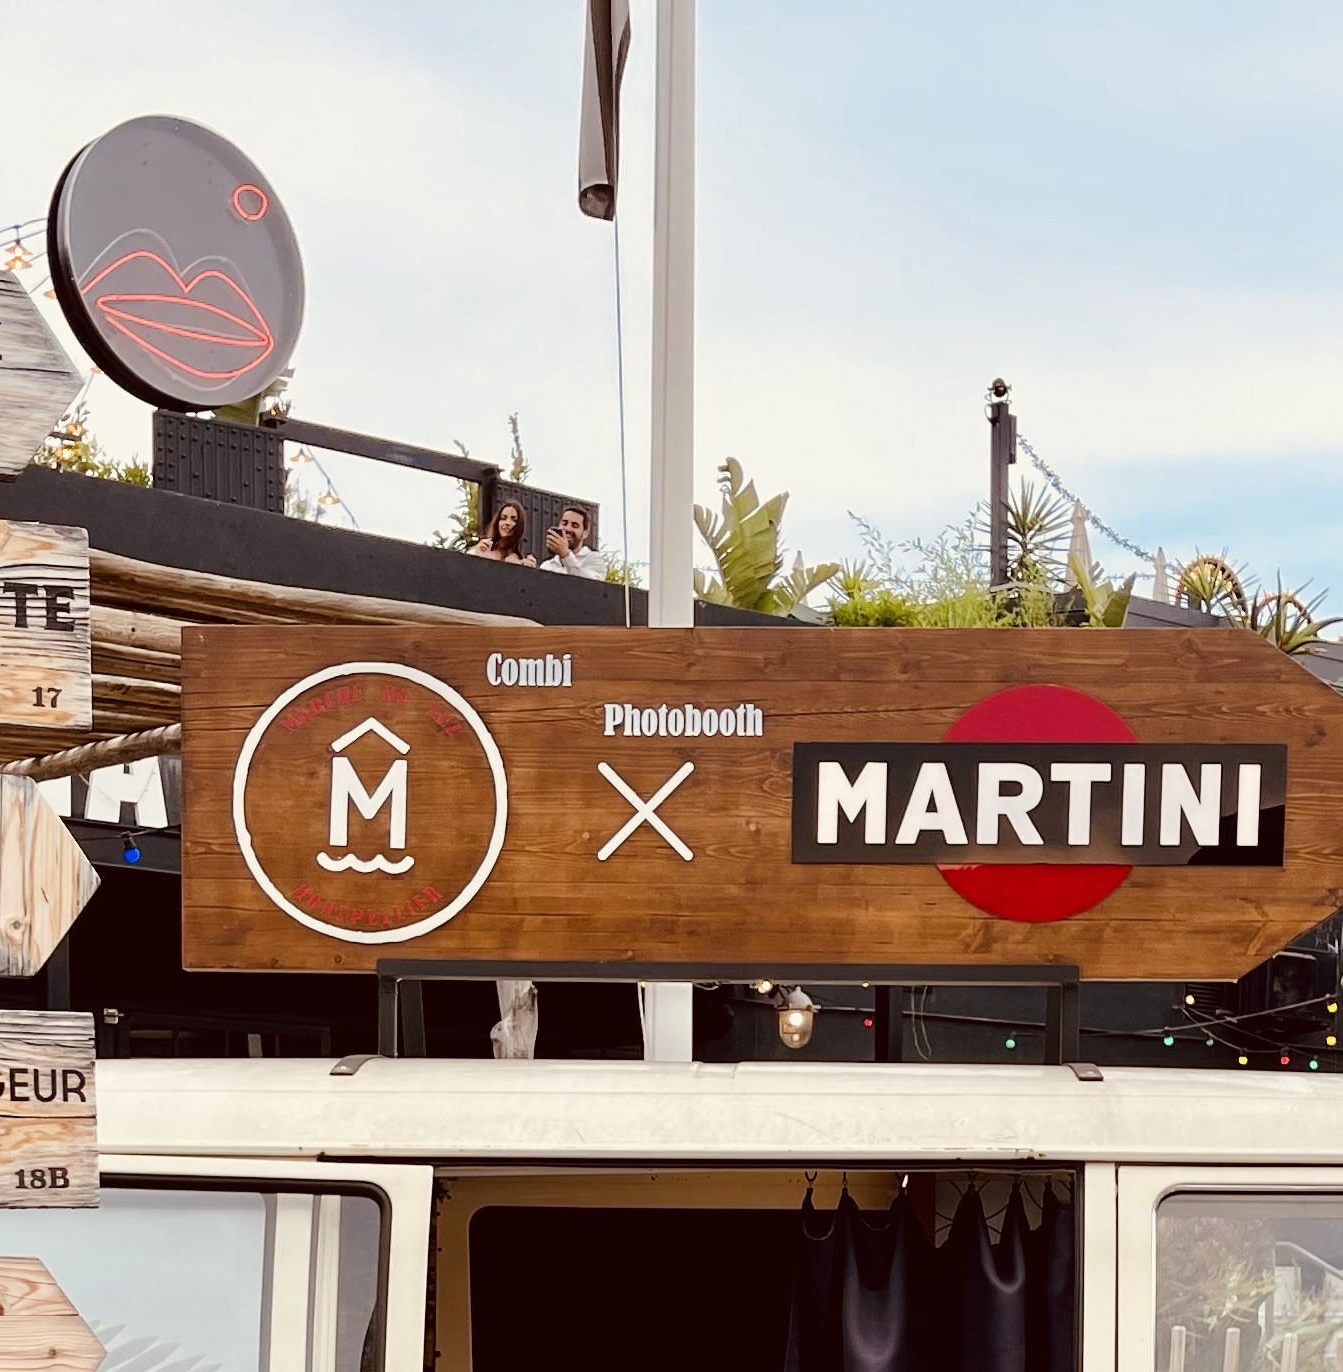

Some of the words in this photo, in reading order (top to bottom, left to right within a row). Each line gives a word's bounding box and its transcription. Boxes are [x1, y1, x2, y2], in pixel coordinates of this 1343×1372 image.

[485, 652, 573, 688] Combi
[32, 686, 63, 708] 17
[603, 703, 765, 738] Photobooth
[816, 761, 1262, 847] MARTINI
[15, 1167, 71, 1190] 18B
